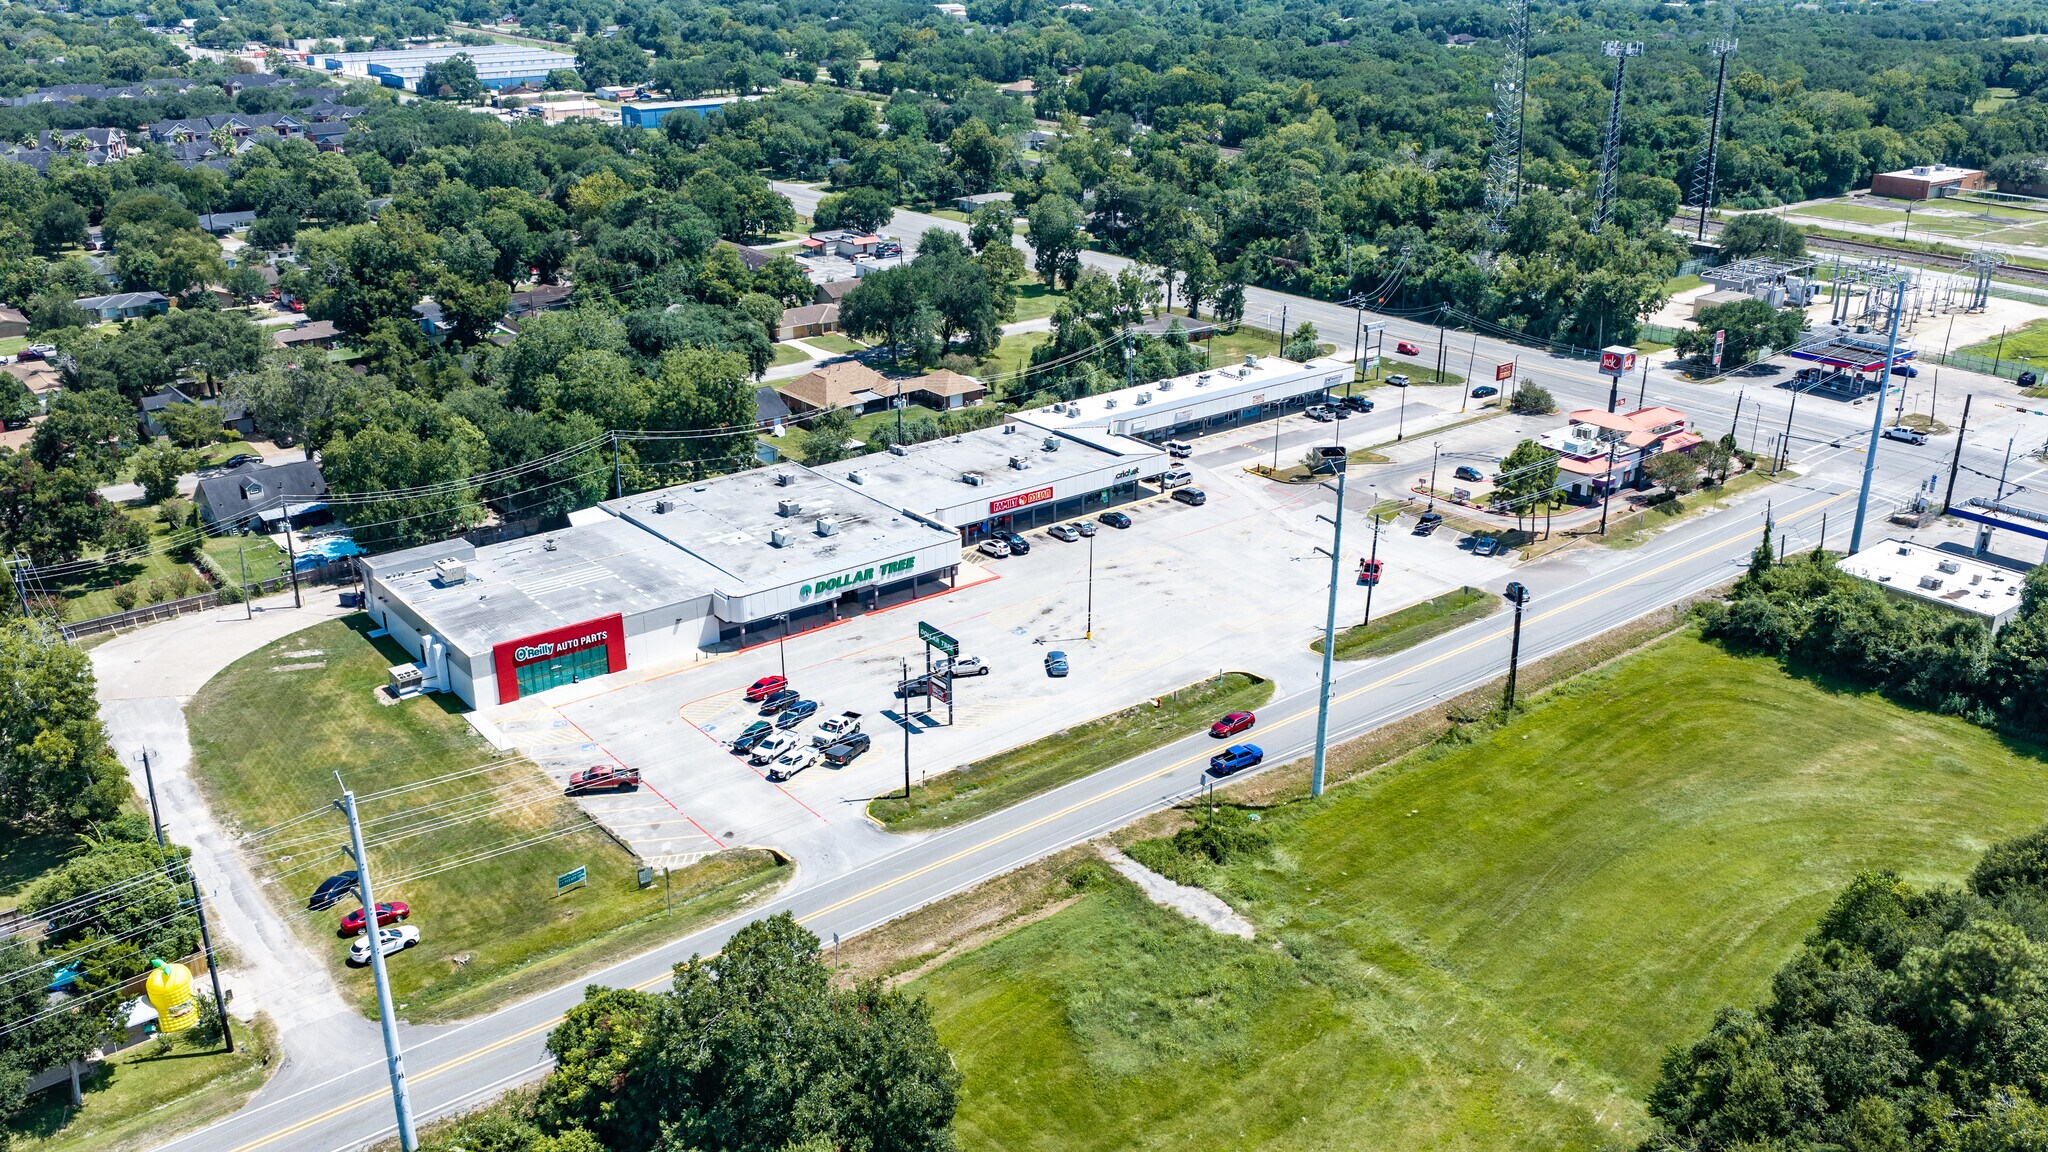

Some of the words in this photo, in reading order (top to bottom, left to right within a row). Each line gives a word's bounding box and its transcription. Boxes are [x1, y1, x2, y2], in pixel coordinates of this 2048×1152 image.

[1116, 467, 1139, 479] cricket
[993, 497, 1018, 512] FAMILY
[1028, 489, 1052, 503] DOLLAR
[815, 568, 874, 594] DOLLAR
[880, 556, 915, 576] TREE
[515, 643, 554, 661] O'Reilly
[556, 638, 579, 652] AUTO
[580, 631, 608, 646] PARTS
